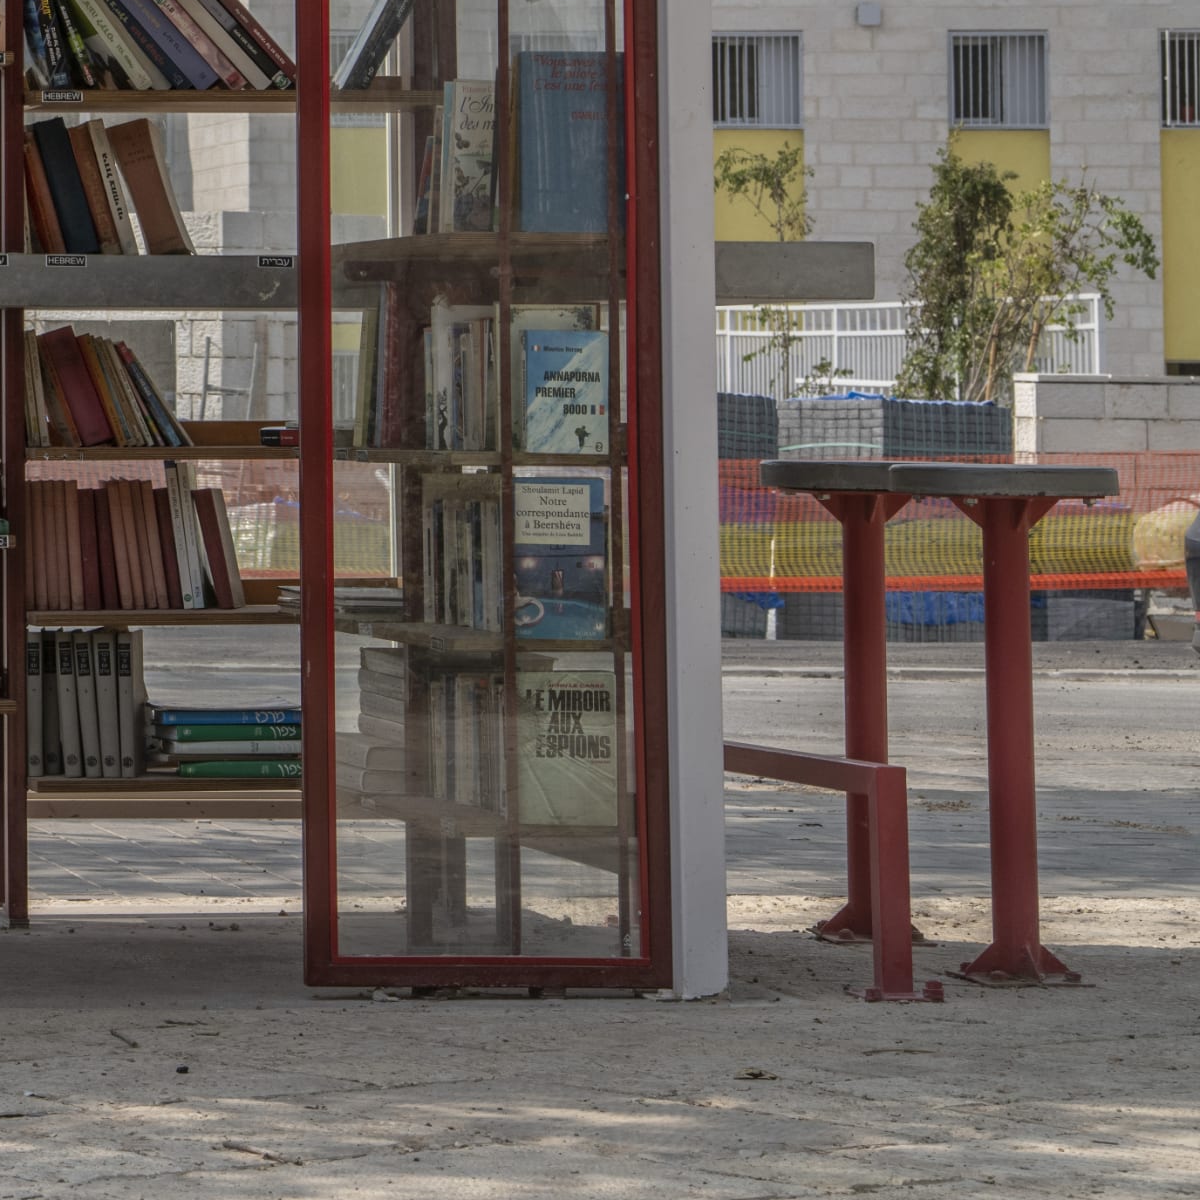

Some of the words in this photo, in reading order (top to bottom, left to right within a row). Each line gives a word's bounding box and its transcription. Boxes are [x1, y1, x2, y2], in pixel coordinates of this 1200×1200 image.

[261, 258, 290, 266] עברית
[544, 371, 600, 382] ANNAPURNA
[536, 386, 576, 398] PREMIER
[563, 404, 588, 415] 8000
[522, 486, 560, 495] Shoulamit
[562, 487, 584, 496] Lapid
[540, 496, 567, 506] Notre
[516, 508, 589, 519] correspondante
[525, 520, 531, 530] à
[533, 520, 581, 530] Beershéva
[550, 690, 610, 712] MIROIR
[255, 712, 284, 723] מרכז
[548, 712, 584, 734] AUX
[270, 727, 296, 738] צפון
[536, 735, 611, 758] ESPIONS
